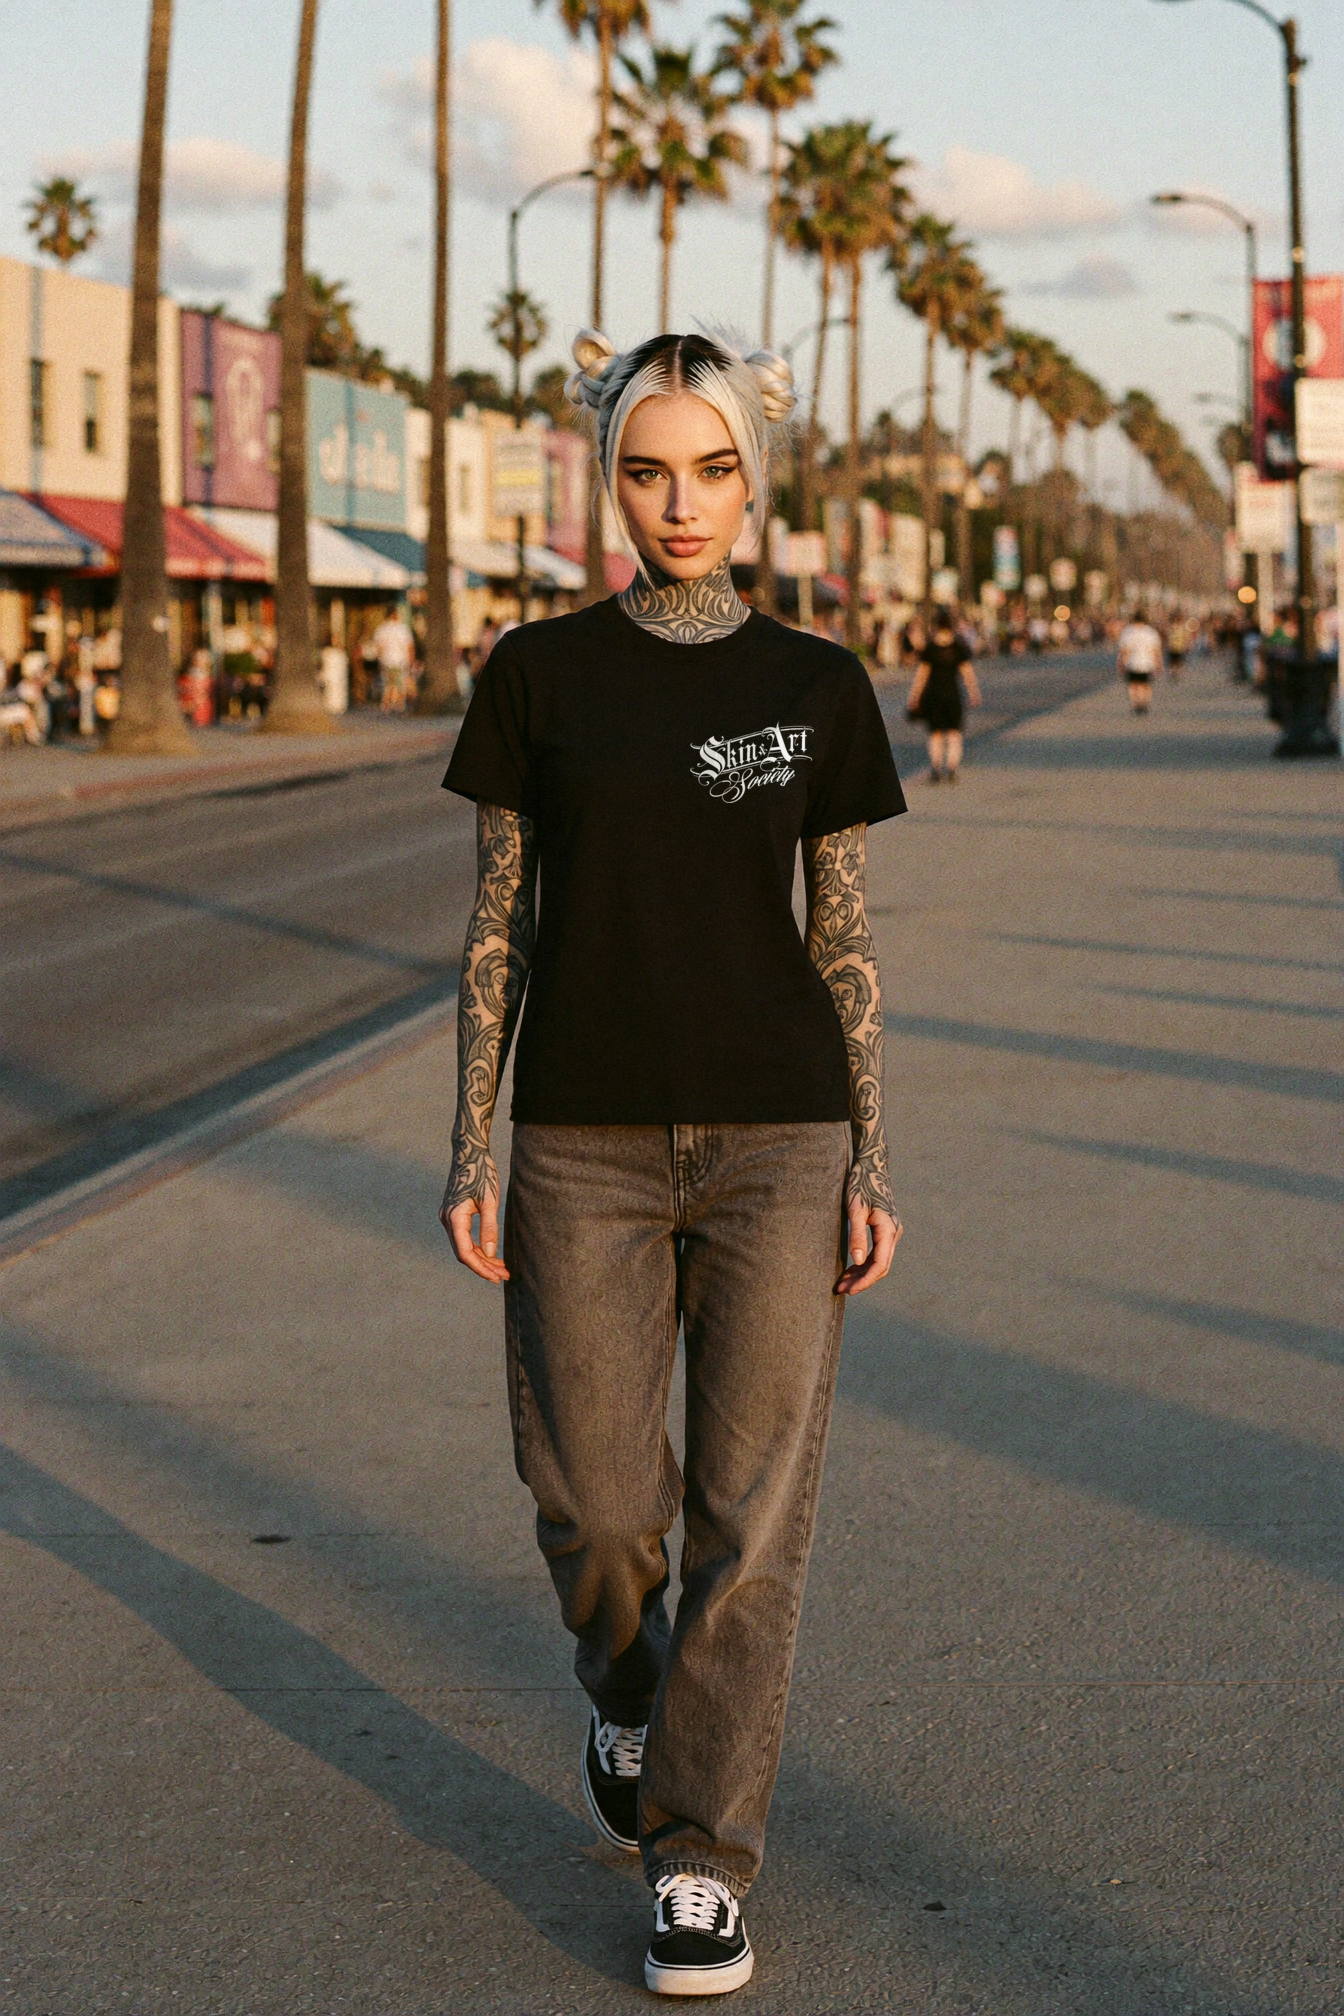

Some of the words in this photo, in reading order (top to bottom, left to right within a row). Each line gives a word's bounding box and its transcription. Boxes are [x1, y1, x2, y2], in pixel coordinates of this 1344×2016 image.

[697, 735, 758, 785] Skin
[760, 721, 808, 766] Art
[709, 765, 796, 803] Society
